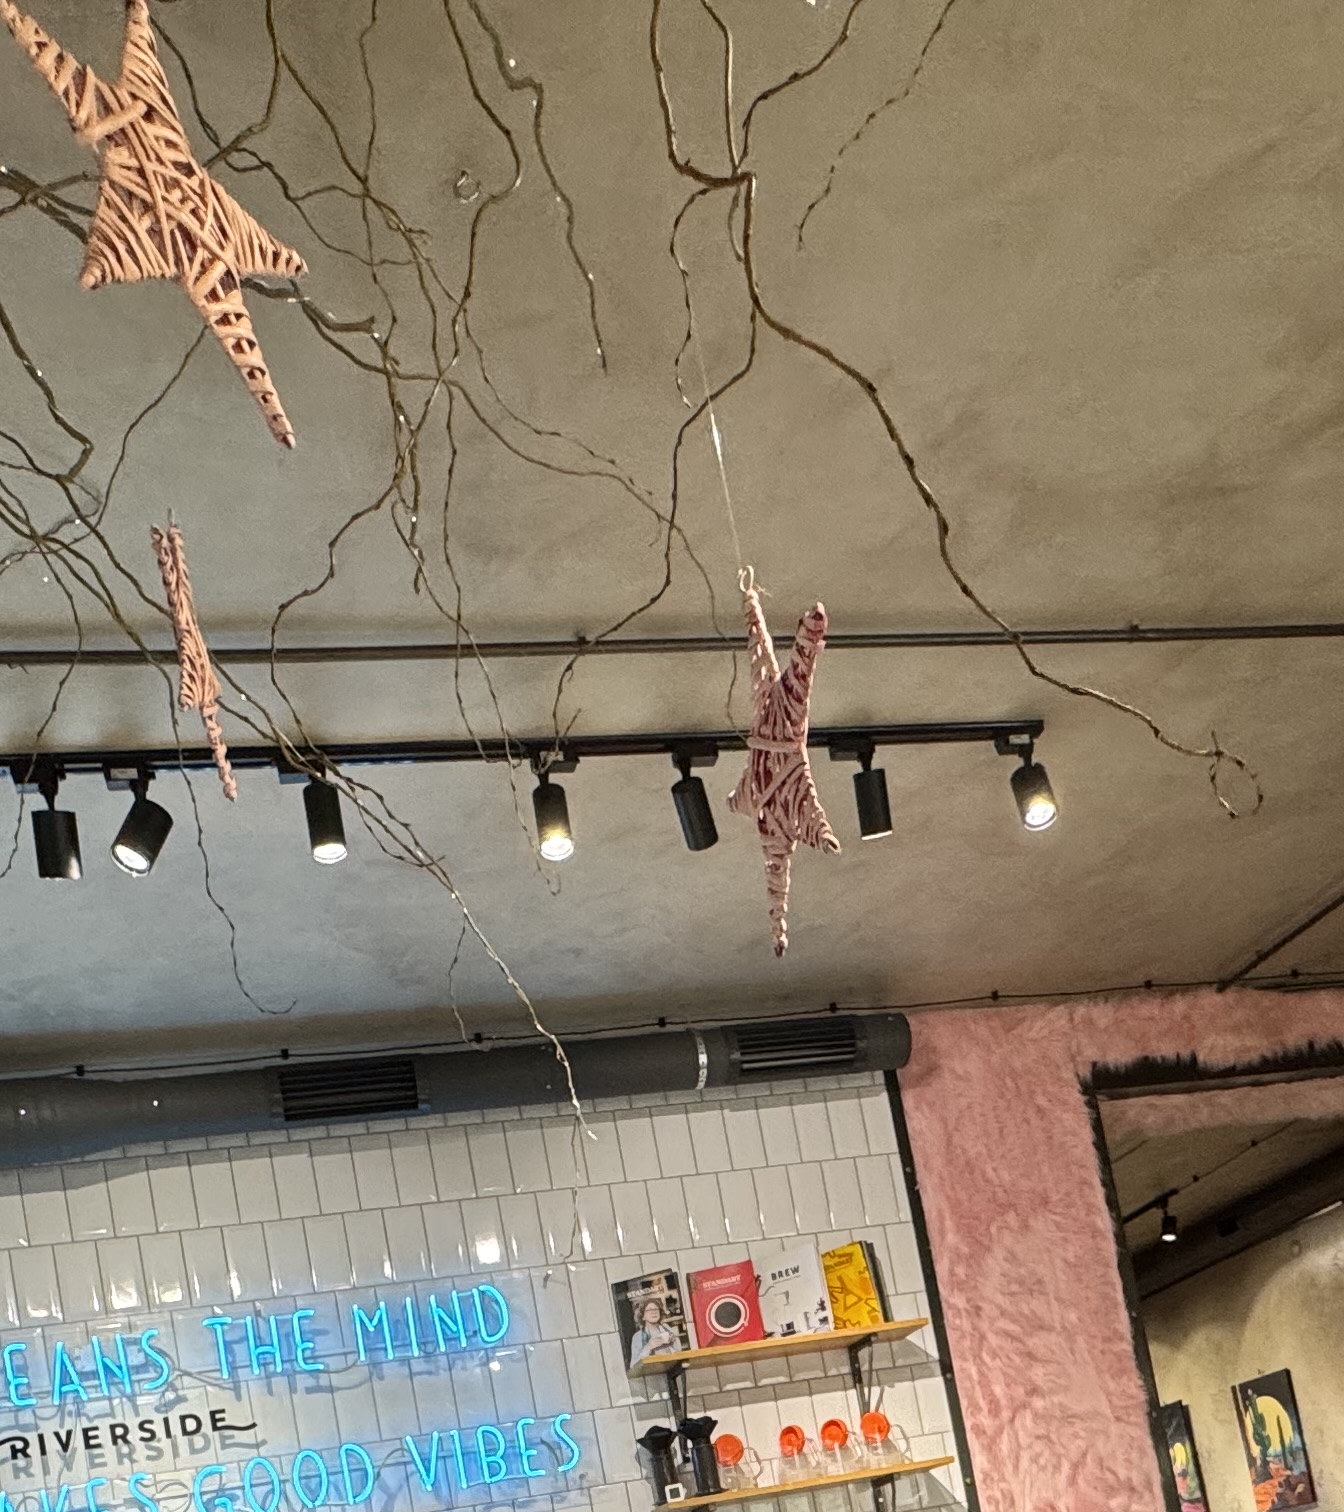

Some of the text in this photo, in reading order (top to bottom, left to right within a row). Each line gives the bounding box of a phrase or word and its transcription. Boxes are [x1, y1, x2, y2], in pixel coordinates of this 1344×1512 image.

[771, 1265, 800, 1281] BREW
[205, 1308, 320, 1378] THE
[353, 1283, 510, 1362] MIND
[405, 1415, 580, 1494] VIBES
